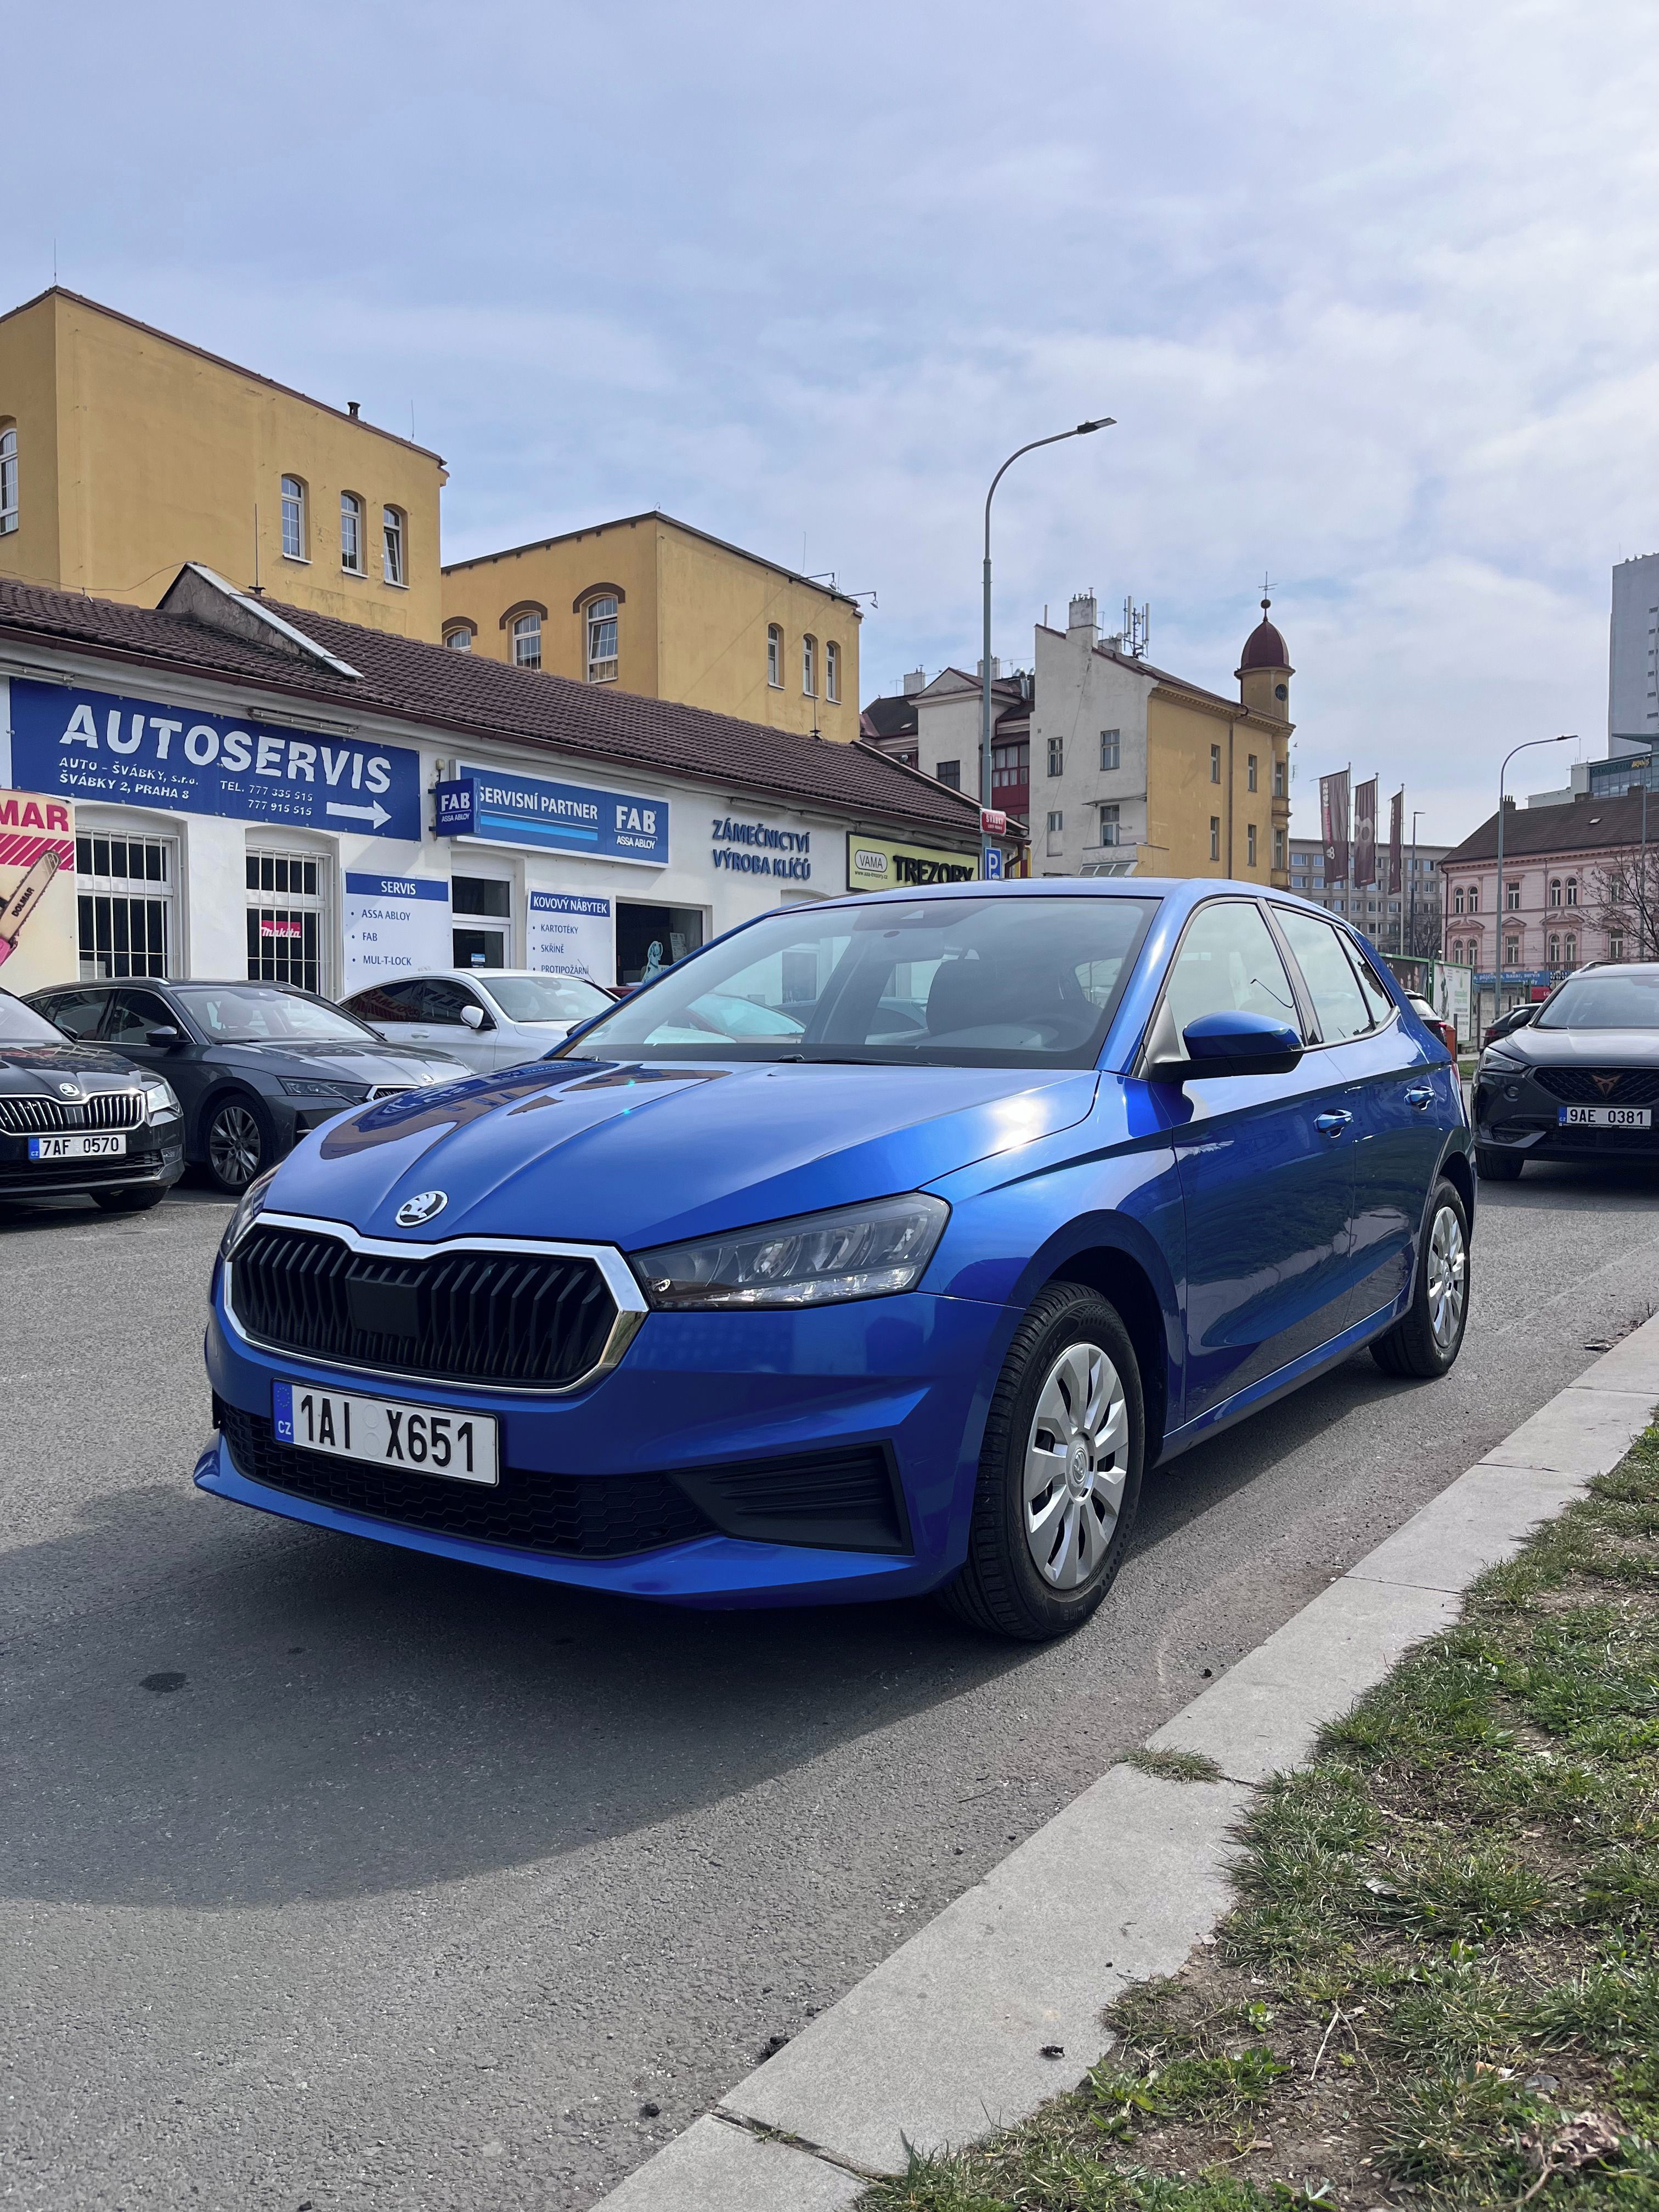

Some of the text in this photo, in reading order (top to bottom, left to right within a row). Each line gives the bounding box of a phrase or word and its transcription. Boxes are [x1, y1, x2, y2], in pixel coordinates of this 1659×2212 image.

[59, 704, 391, 793] AUTOSERVIS
[59, 757, 97, 771] AUTO
[112, 761, 167, 783] ŠVÁBKY,
[171, 775, 199, 785] s.r.o.
[59, 769, 189, 799] ŠVÁBKY 2, PRAHA 8
[220, 780, 313, 802] TEL. 777 335 515
[248, 799, 312, 816] 777 915 515
[441, 792, 471, 812] FAB
[480, 786, 598, 820] SERVISNÍ PARTNER
[454, 812, 471, 821] ABLOY
[616, 805, 656, 834] FAB
[616, 835, 656, 850] ASSA ABLOY
[712, 817, 811, 853] ZÁMEČNICTVÍ
[713, 847, 811, 881] VÝROBA KLÍČŮ
[859, 854, 883, 870] VAMA
[893, 855, 975, 884] TREZORY
[988, 853, 998, 879] P
[381, 881, 416, 895] SERVIS
[11, 887, 35, 918] DOLMAR
[533, 895, 607, 914] KOVOVÝ NÁBYTEK
[362, 909, 411, 921] ASSA ABLOY
[362, 932, 378, 941] FAB
[540, 923, 579, 934] KARTOTÉKY
[540, 943, 565, 953] SKŘÍNĚ
[363, 955, 412, 966] MUL-T-LOCK
[540, 964, 590, 975] PROTIPOŽÁRNÍ
[1570, 1109, 1644, 1125] 9AE 0381
[42, 1137, 119, 1156] 7AF 0570
[278, 1420, 292, 1436] CZ
[301, 1394, 474, 1472] 1AI X651
